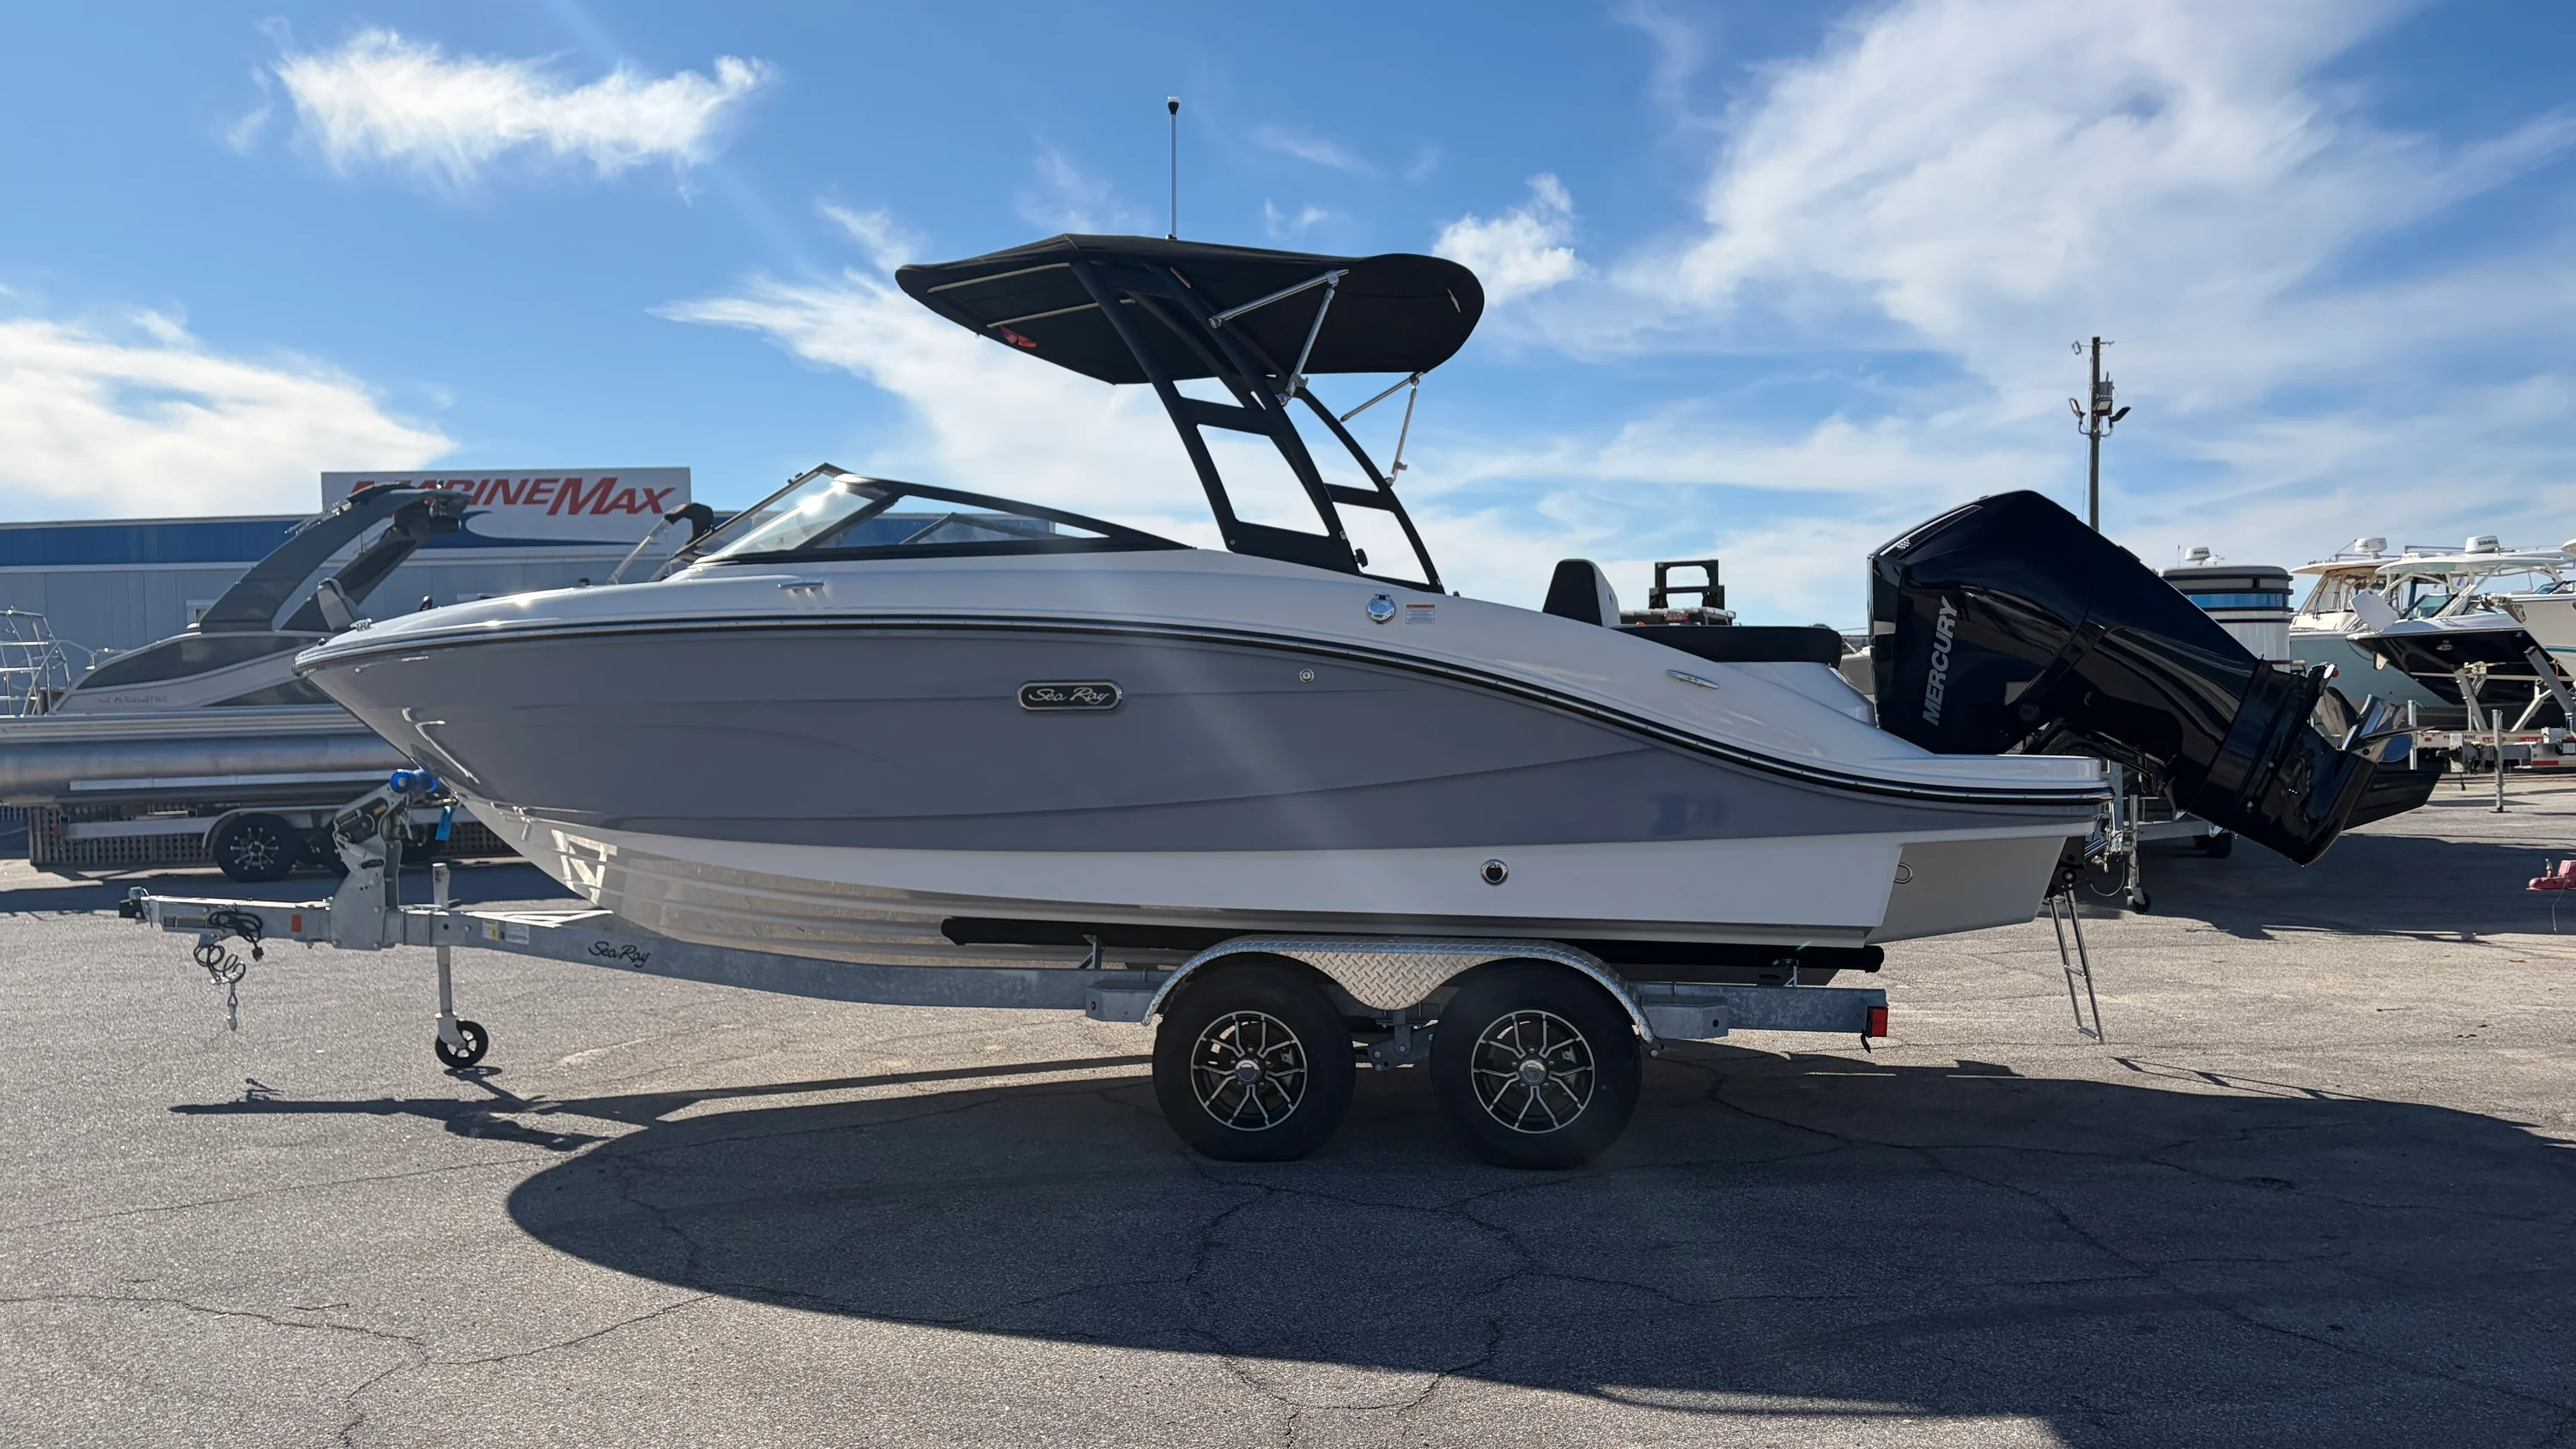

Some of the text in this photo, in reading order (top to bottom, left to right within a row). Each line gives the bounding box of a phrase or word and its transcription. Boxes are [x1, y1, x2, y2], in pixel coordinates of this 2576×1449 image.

[349, 476, 676, 517] RINEMAX
[1922, 595, 1958, 727] MERCURY
[1028, 687, 1109, 705] Sea Ray
[587, 941, 651, 968] Sea Ray
